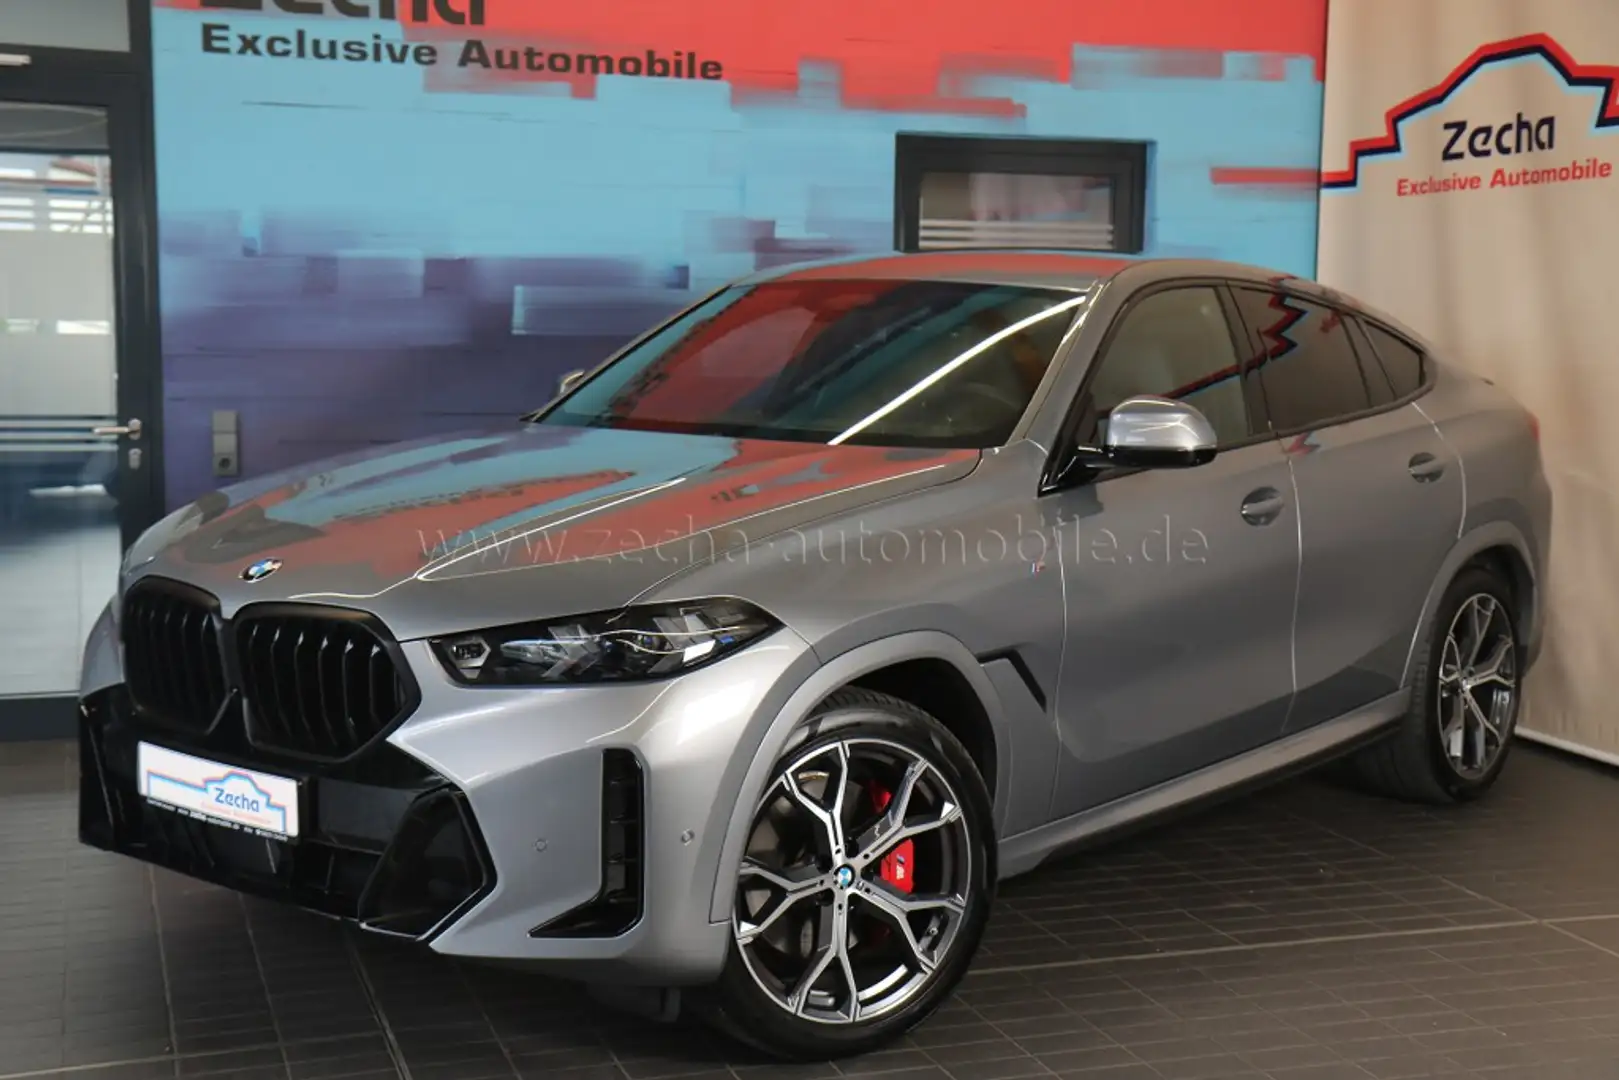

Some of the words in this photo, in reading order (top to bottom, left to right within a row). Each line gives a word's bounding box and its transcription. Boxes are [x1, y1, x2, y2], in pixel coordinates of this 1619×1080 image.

[201, 22, 438, 66] Exclusive
[457, 39, 724, 81] Automobile
[1441, 112, 1556, 161] Zecha
[1396, 173, 1482, 197] Exclusive
[1489, 157, 1613, 189] Automobile
[213, 787, 260, 813] Zecha
